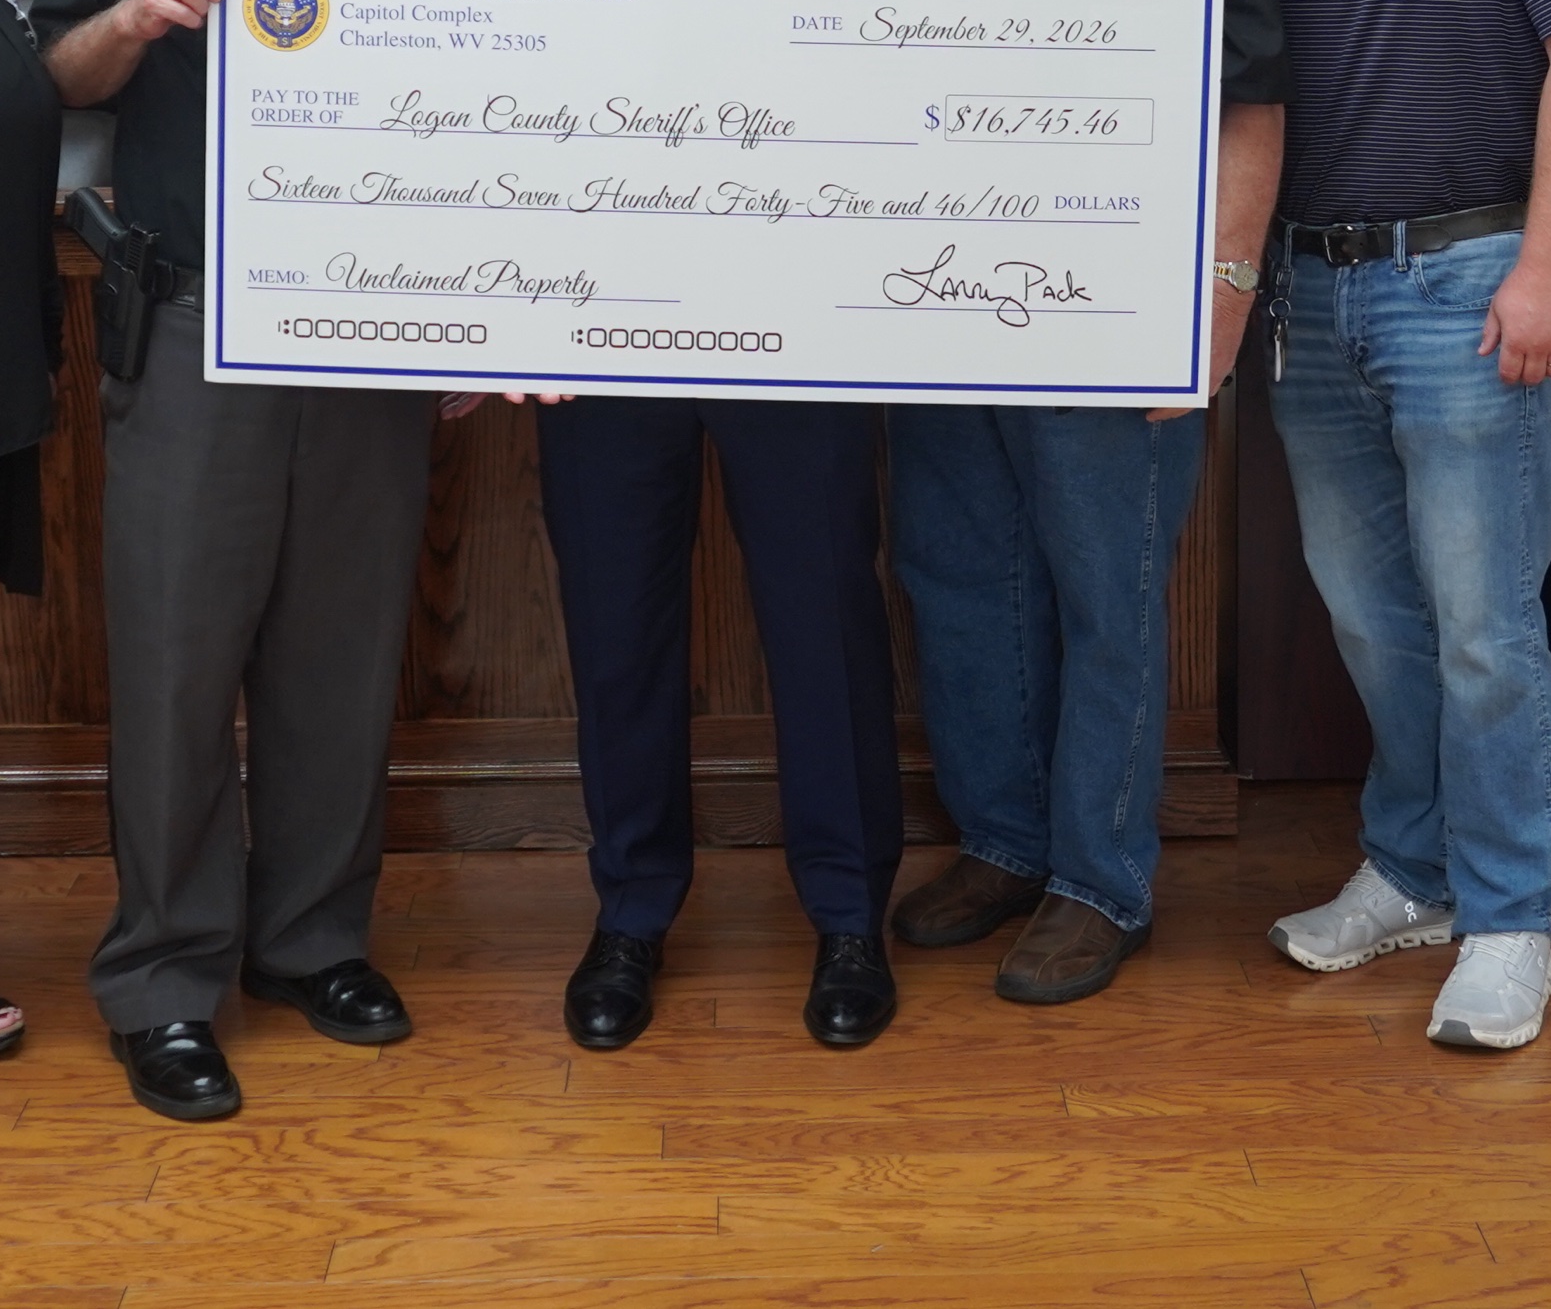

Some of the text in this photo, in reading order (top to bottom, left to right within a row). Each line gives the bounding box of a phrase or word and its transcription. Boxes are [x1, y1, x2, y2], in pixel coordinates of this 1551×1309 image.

[340, 3, 493, 25] Capitol Complex
[792, 6, 1118, 48] DATE September 29, 2026
[339, 29, 547, 52] Charleston, WV 25305
[251, 90, 359, 106] PAY TO THE
[251, 107, 314, 124] ORDER
[318, 109, 343, 124] OF
[380, 90, 473, 139] Logan
[482, 94, 582, 142] County
[589, 96, 707, 148] Sheriff's
[718, 101, 796, 150] Office
[947, 105, 1119, 136] $16,745.46
[248, 165, 1141, 224] Sixteen Thousand Seven Hundred Forty-Five and 46/100 DOLLARS
[248, 252, 599, 307] MEMO: Unclaimed Property
